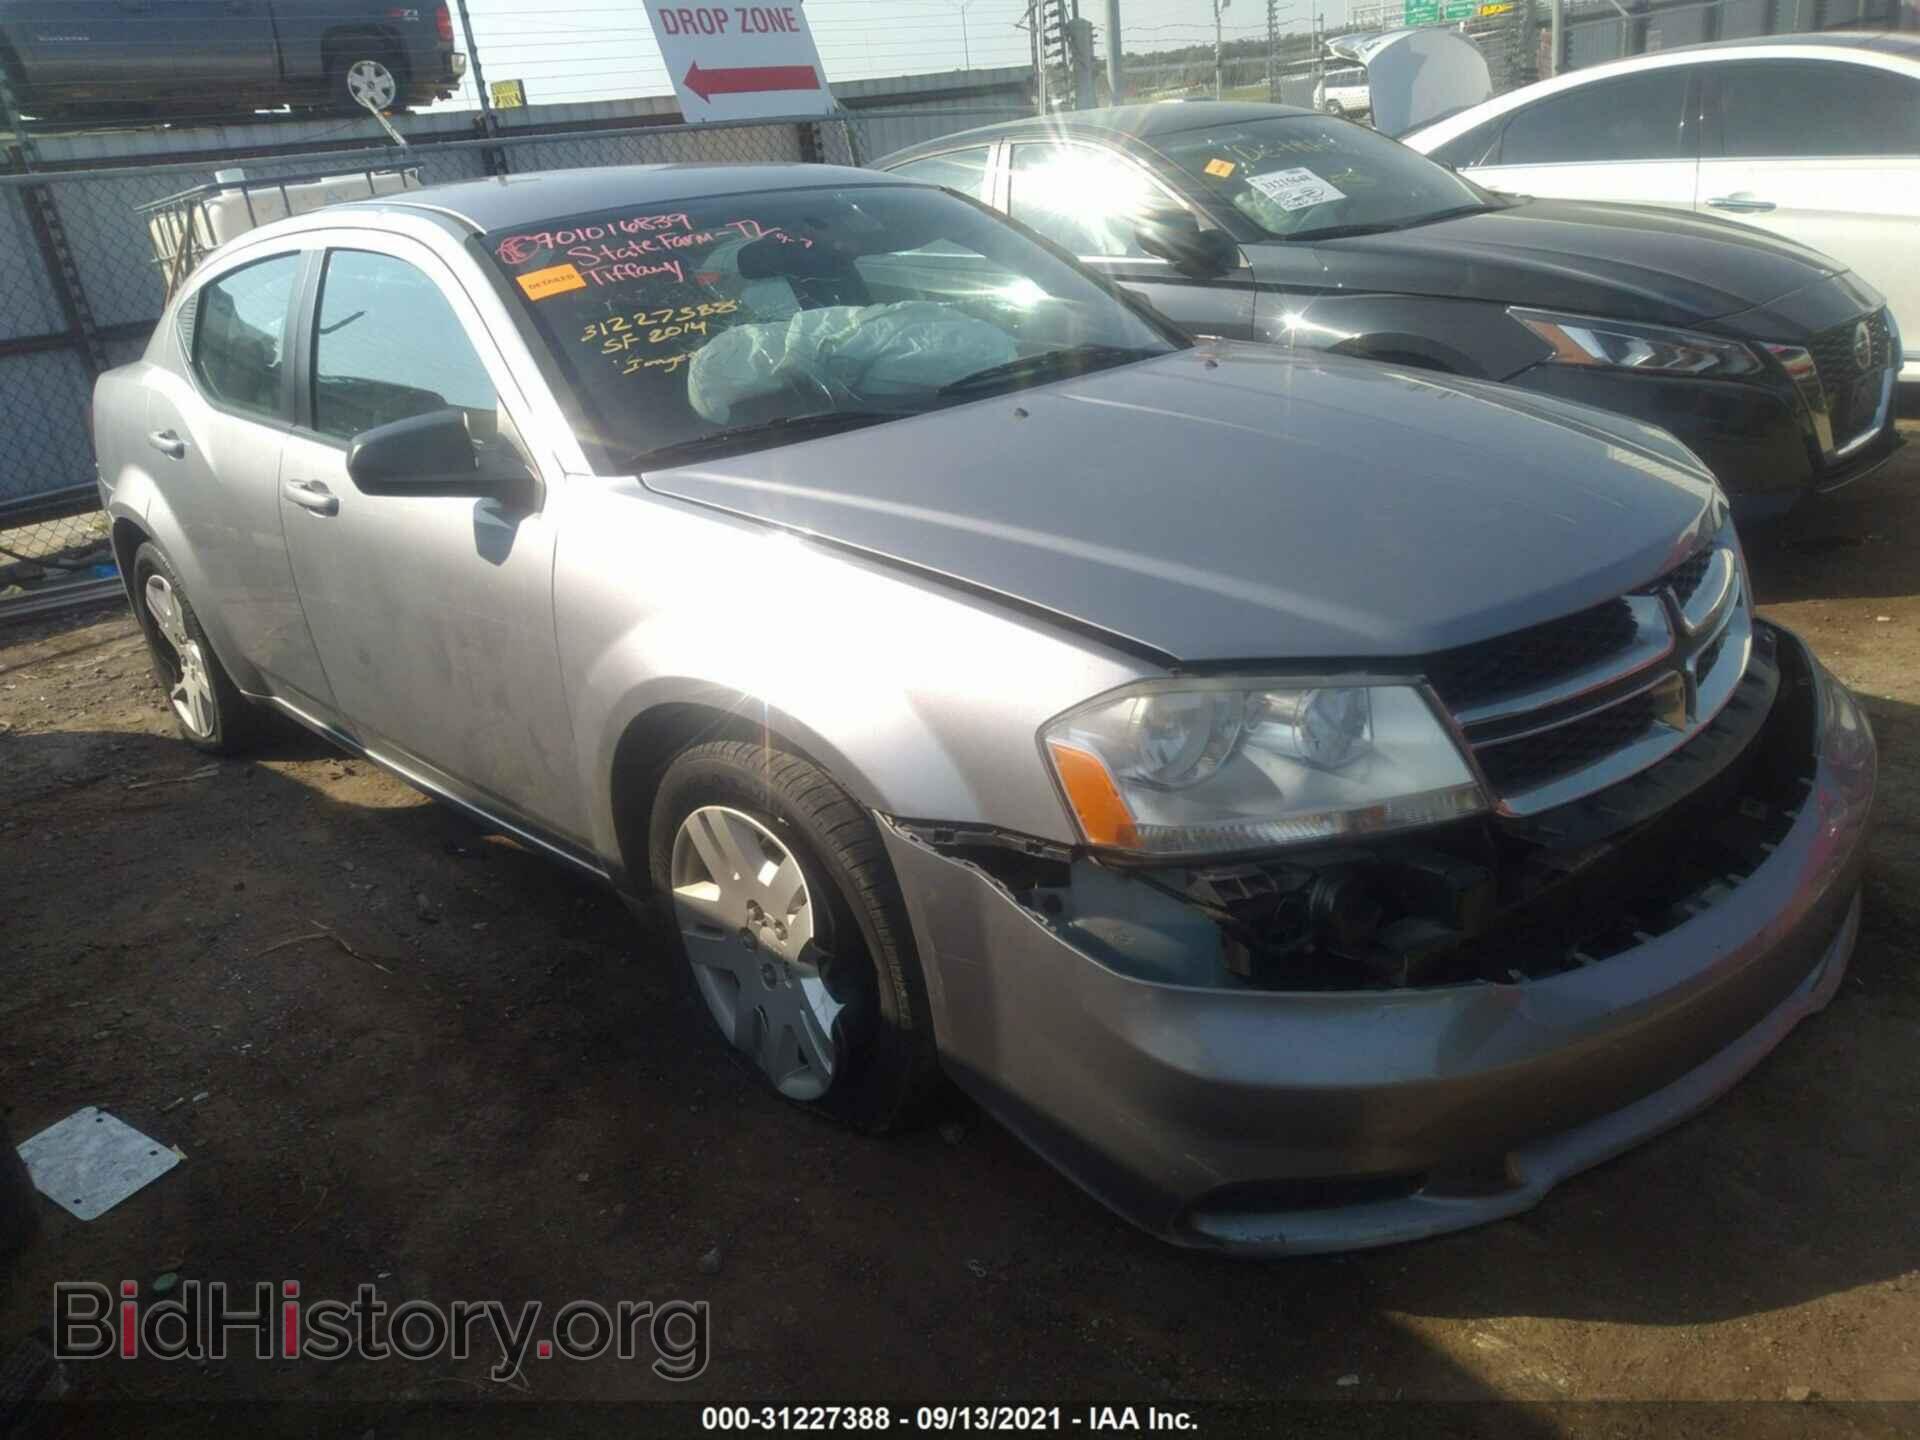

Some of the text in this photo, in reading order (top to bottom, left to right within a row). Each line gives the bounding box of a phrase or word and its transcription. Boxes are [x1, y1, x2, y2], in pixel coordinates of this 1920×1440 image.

[658, 7, 801, 35] DROP ZONE
[568, 239, 657, 267] State
[580, 260, 684, 286] Tiffany
[602, 321, 706, 355] SF 2014
